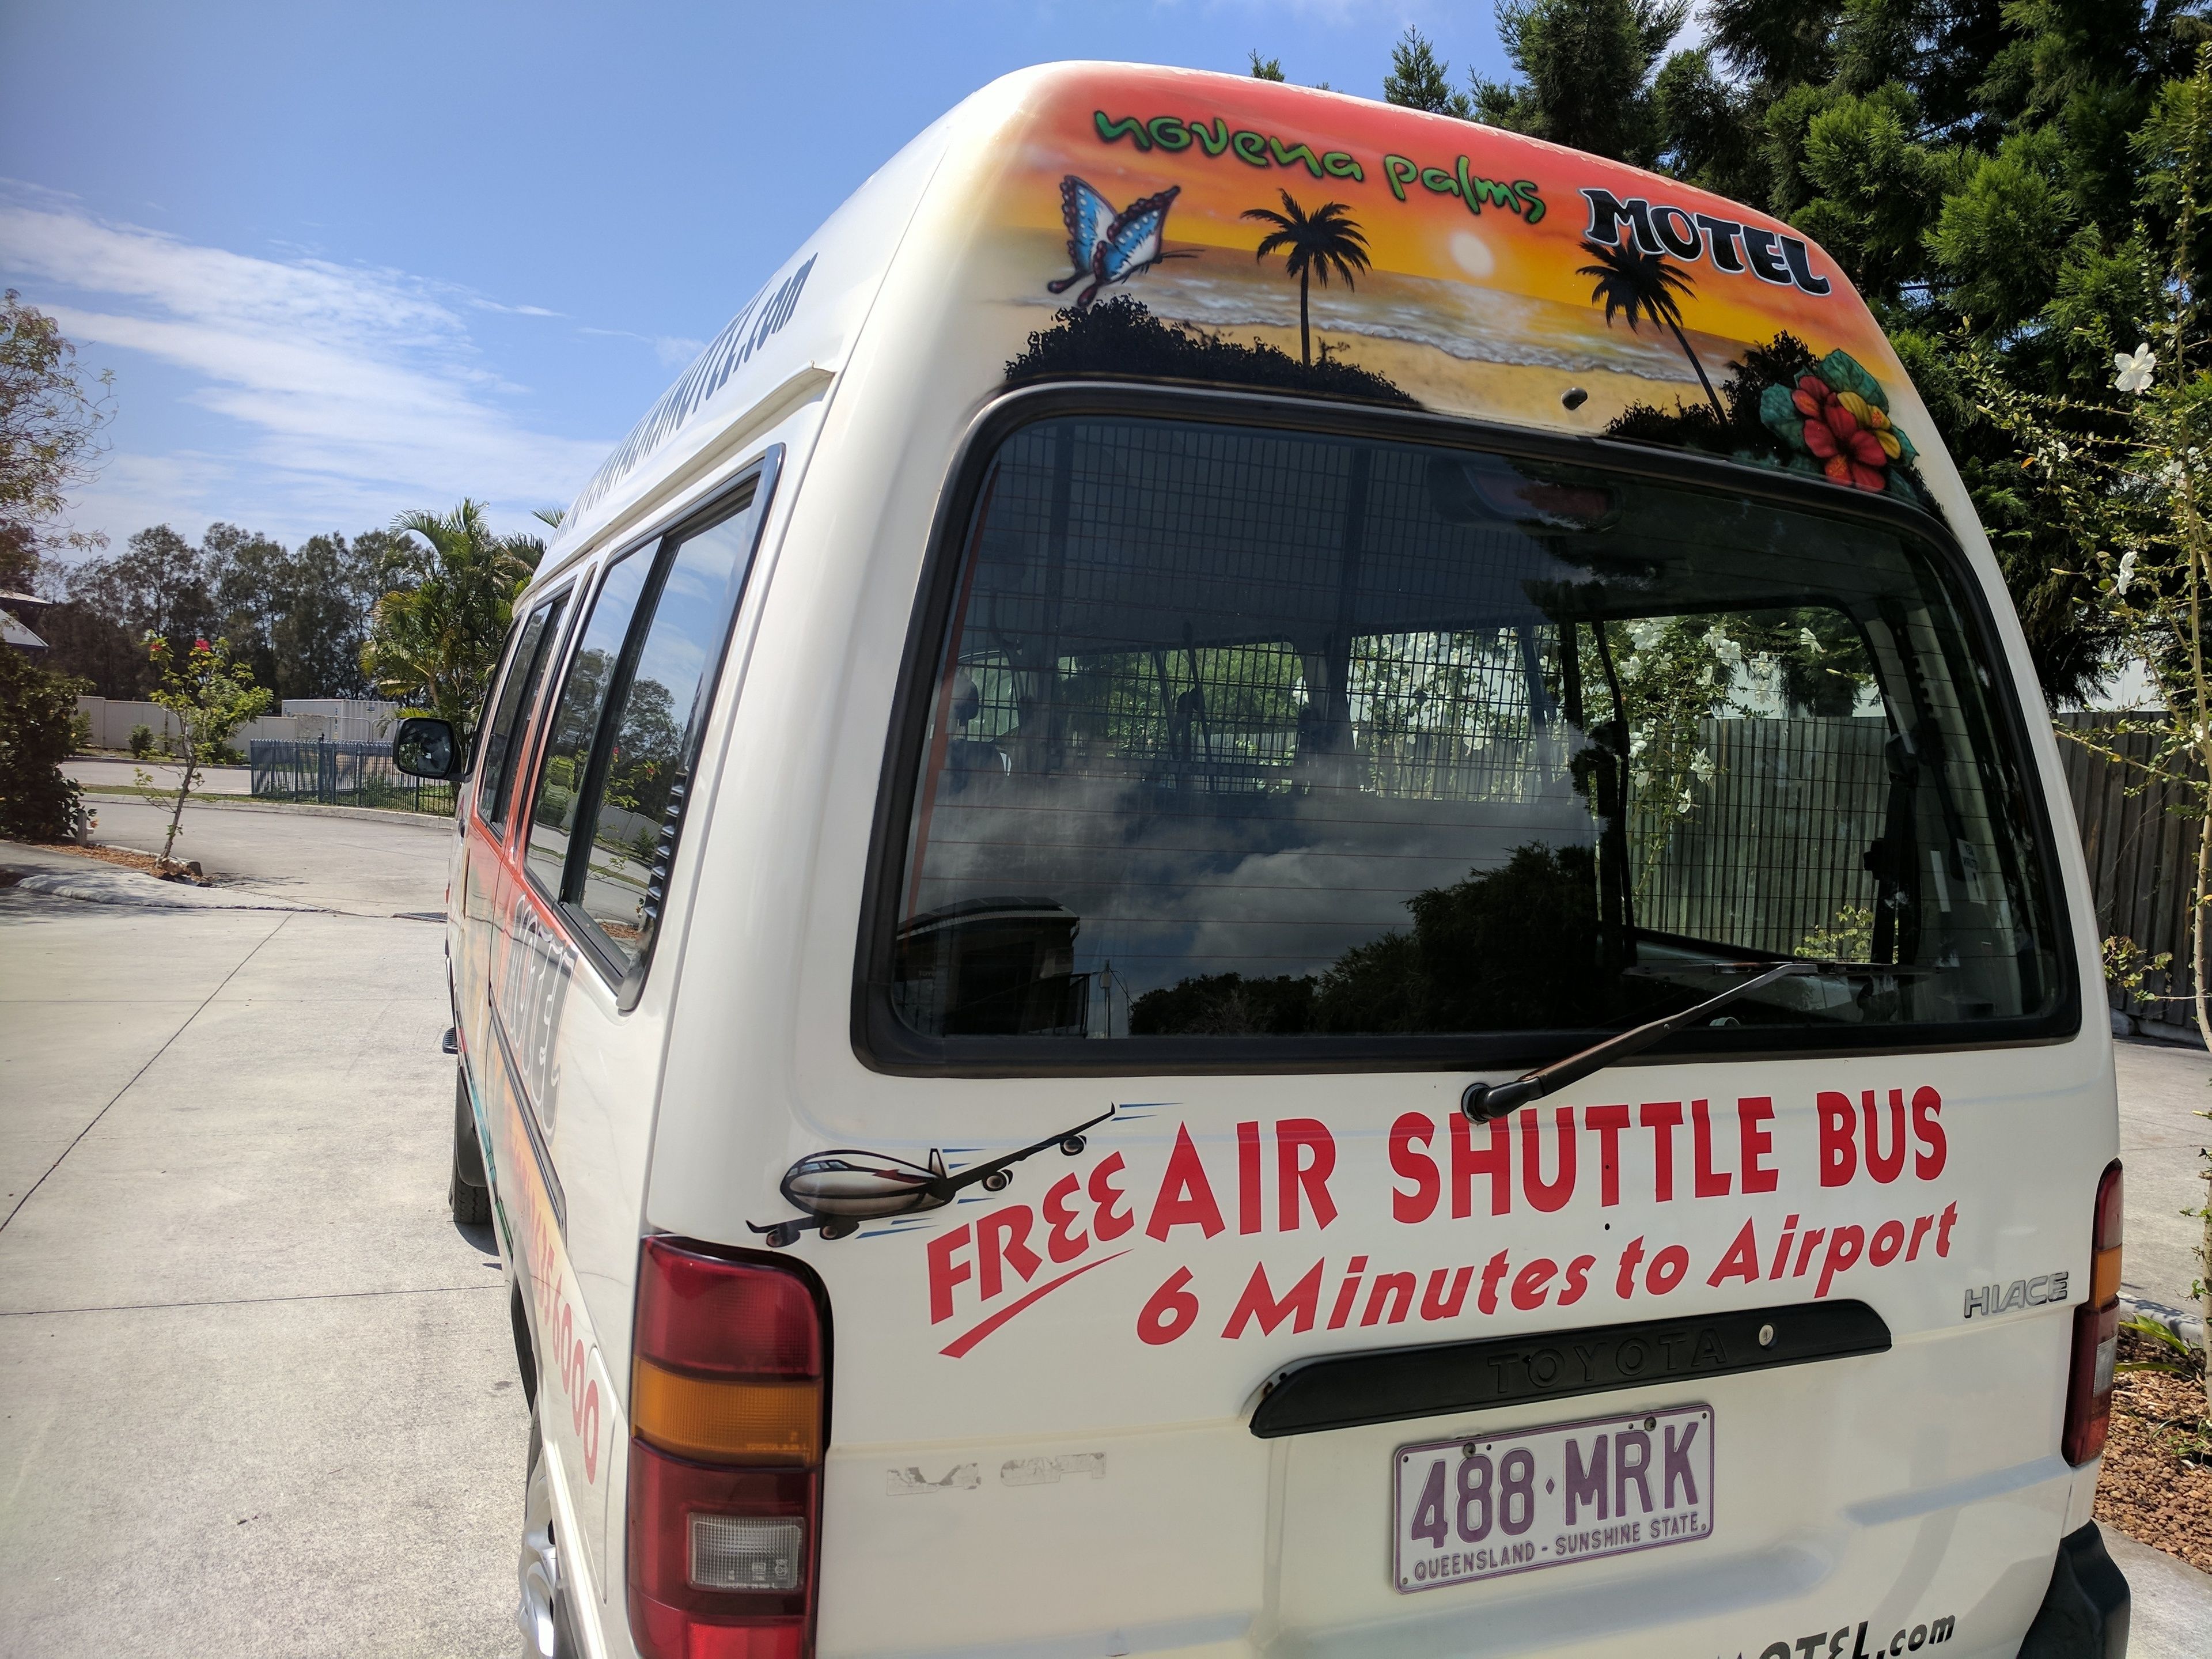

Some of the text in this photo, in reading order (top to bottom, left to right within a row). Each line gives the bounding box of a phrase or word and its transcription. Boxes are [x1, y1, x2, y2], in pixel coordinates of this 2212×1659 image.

[1094, 110, 1832, 296] novena palms MOTEL
[927, 1086, 1946, 1325] FREE AIR SHUTTLE BUS
[1137, 1203, 1956, 1345] 6 Minutes to Airport
[1964, 1271, 2069, 1319] HIACE
[1487, 1327, 1727, 1393] TOYOTA
[1414, 1541, 1535, 1581] QUEENSLAND
[1555, 1521, 1641, 1556] SUNSHINE
[1650, 1512, 1699, 1540] STATE
